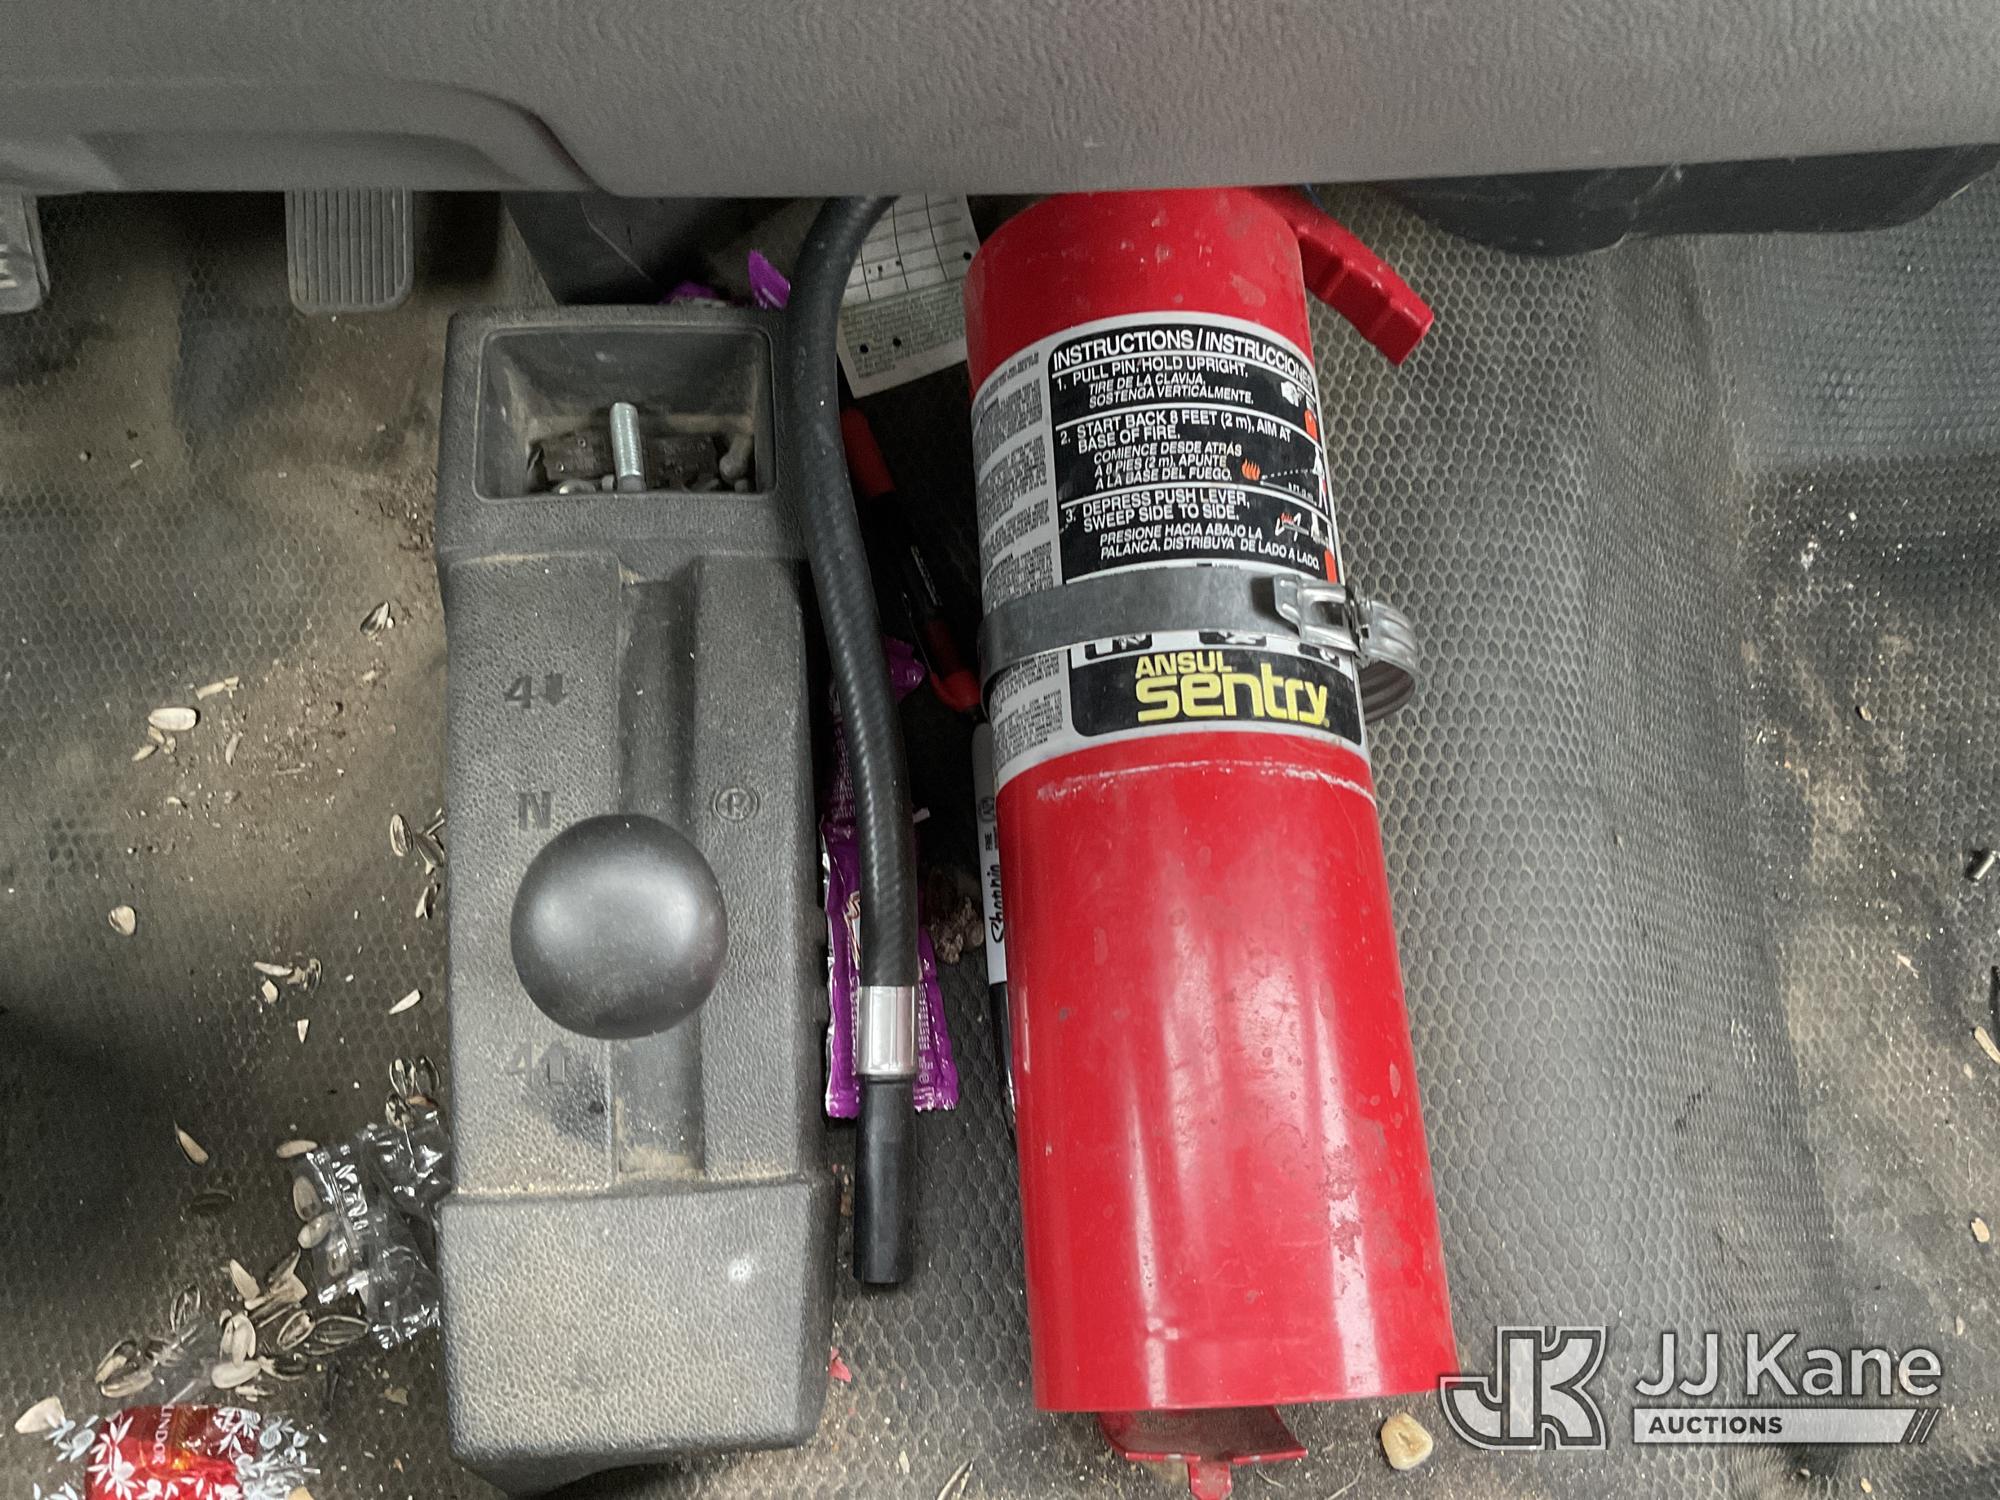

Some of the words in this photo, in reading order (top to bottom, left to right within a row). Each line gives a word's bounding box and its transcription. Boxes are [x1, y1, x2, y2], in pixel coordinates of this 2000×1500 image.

[1073, 365, 1109, 386] PULL
[1142, 356, 1183, 372] HOLD
[1089, 379, 1114, 395] TIRE
[1117, 376, 1133, 389] DE
[1136, 374, 1151, 387] LA
[1089, 386, 1154, 408] SOSTENGA
[1077, 416, 1121, 439] START
[1125, 410, 1167, 428] BACK
[1170, 410, 1178, 425] 8
[1182, 410, 1217, 425] FEET
[1256, 419, 1277, 437] AIM
[1280, 426, 1291, 442] AT
[1079, 432, 1116, 454] BASE
[1120, 428, 1140, 444] OF
[1144, 425, 1180, 441] FIRE.
[1094, 442, 1158, 465] COMIENCE
[1161, 441, 1202, 455] DESDE
[1204, 441, 1242, 457] ATRÁS
[1095, 465, 1103, 478] A
[1115, 457, 1142, 473] PIES
[1178, 454, 1227, 468] APUNTE
[1096, 478, 1104, 491] A
[1107, 474, 1122, 488] LA
[1125, 468, 1159, 485] BASE
[1162, 467, 1185, 480] DEL
[1083, 491, 1151, 518] DEPRESS
[1154, 488, 1196, 505] PUSH
[1200, 488, 1250, 509] LEVER,
[1083, 509, 1135, 533] SWEEP
[1139, 504, 1174, 522] SIDE
[1178, 504, 1199, 519] TO
[1202, 504, 1240, 520] SIDE.
[1100, 524, 1162, 547] PRESIONE
[1165, 523, 1203, 537] HACIA
[1205, 523, 1246, 538] ABAJO
[1248, 526, 1263, 540] LA
[1163, 536, 1235, 551] DISTRIBUYA
[1240, 539, 1256, 553] DE
[1258, 540, 1287, 558] LADO
[1288, 547, 1296, 560] A
[1135, 650, 1233, 678] ANSUL
[504, 674, 532, 709] 4
[518, 790, 552, 830] N
